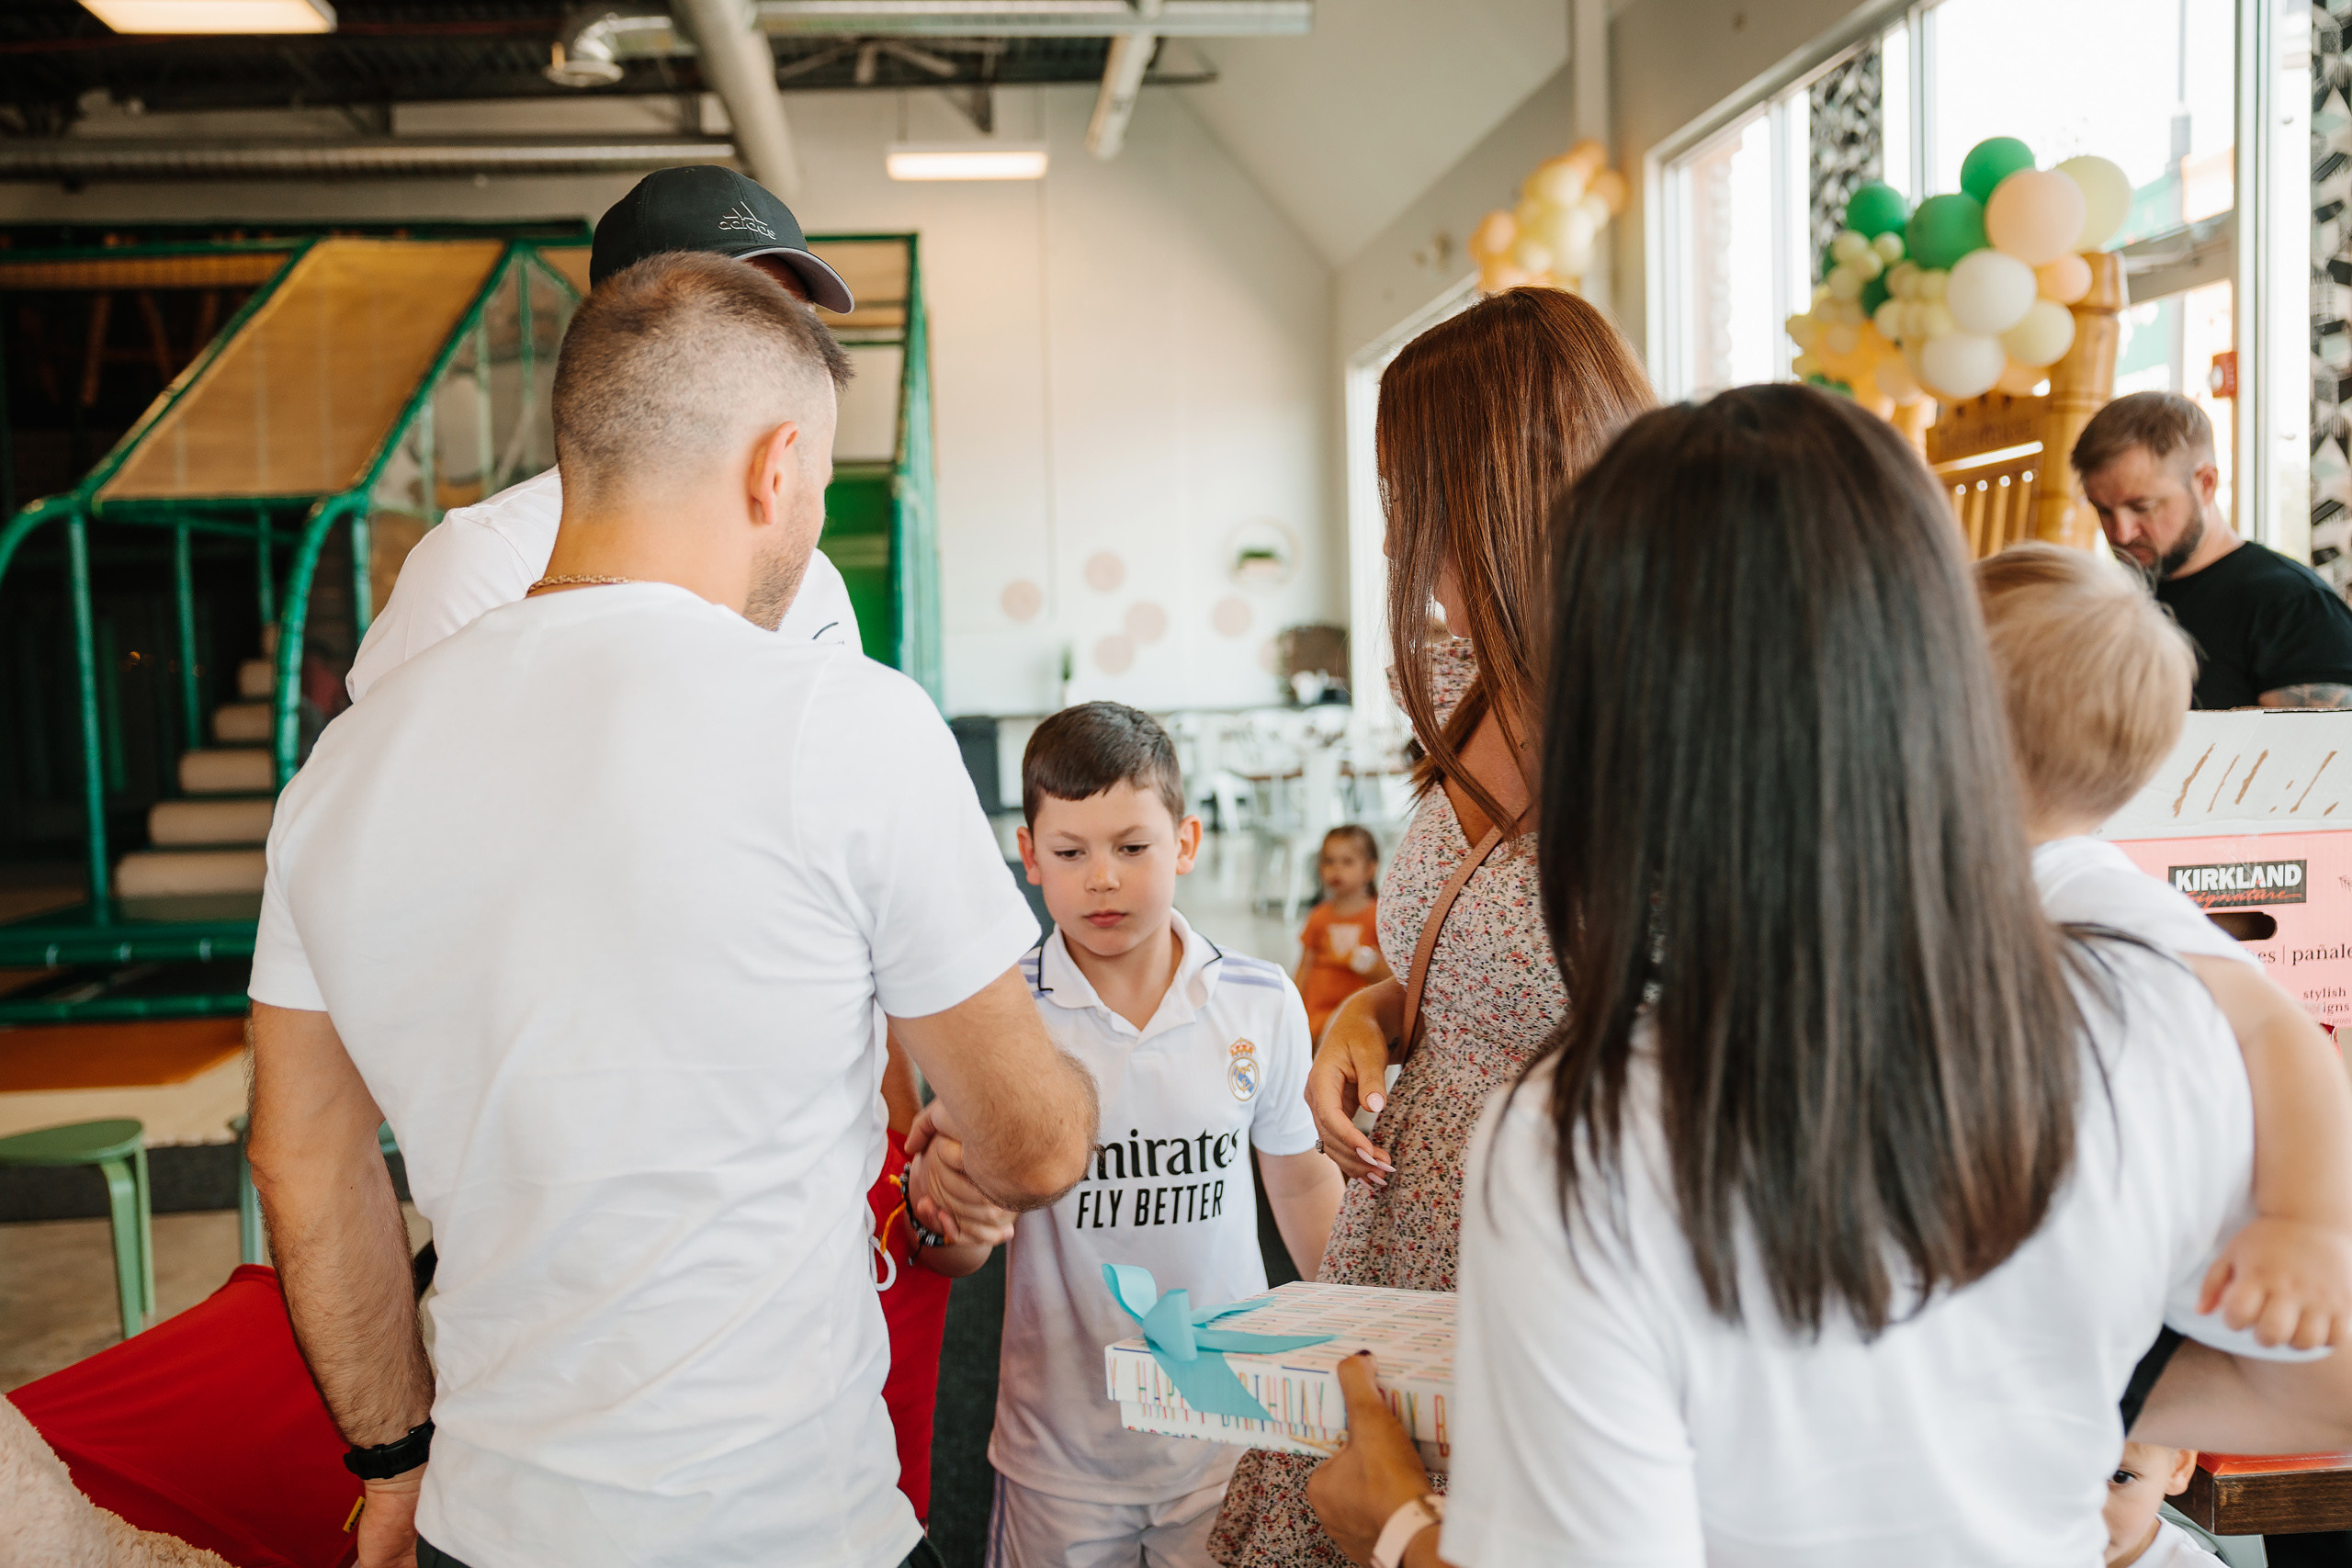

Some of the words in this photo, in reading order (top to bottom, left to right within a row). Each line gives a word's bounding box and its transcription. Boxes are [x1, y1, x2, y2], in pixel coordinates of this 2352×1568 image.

[2175, 863, 2303, 892] KIRKLAND
[2302, 987, 2346, 1001] stylish
[1076, 1189, 1124, 1229] FLY
[1134, 1179, 1225, 1227] BETTER
